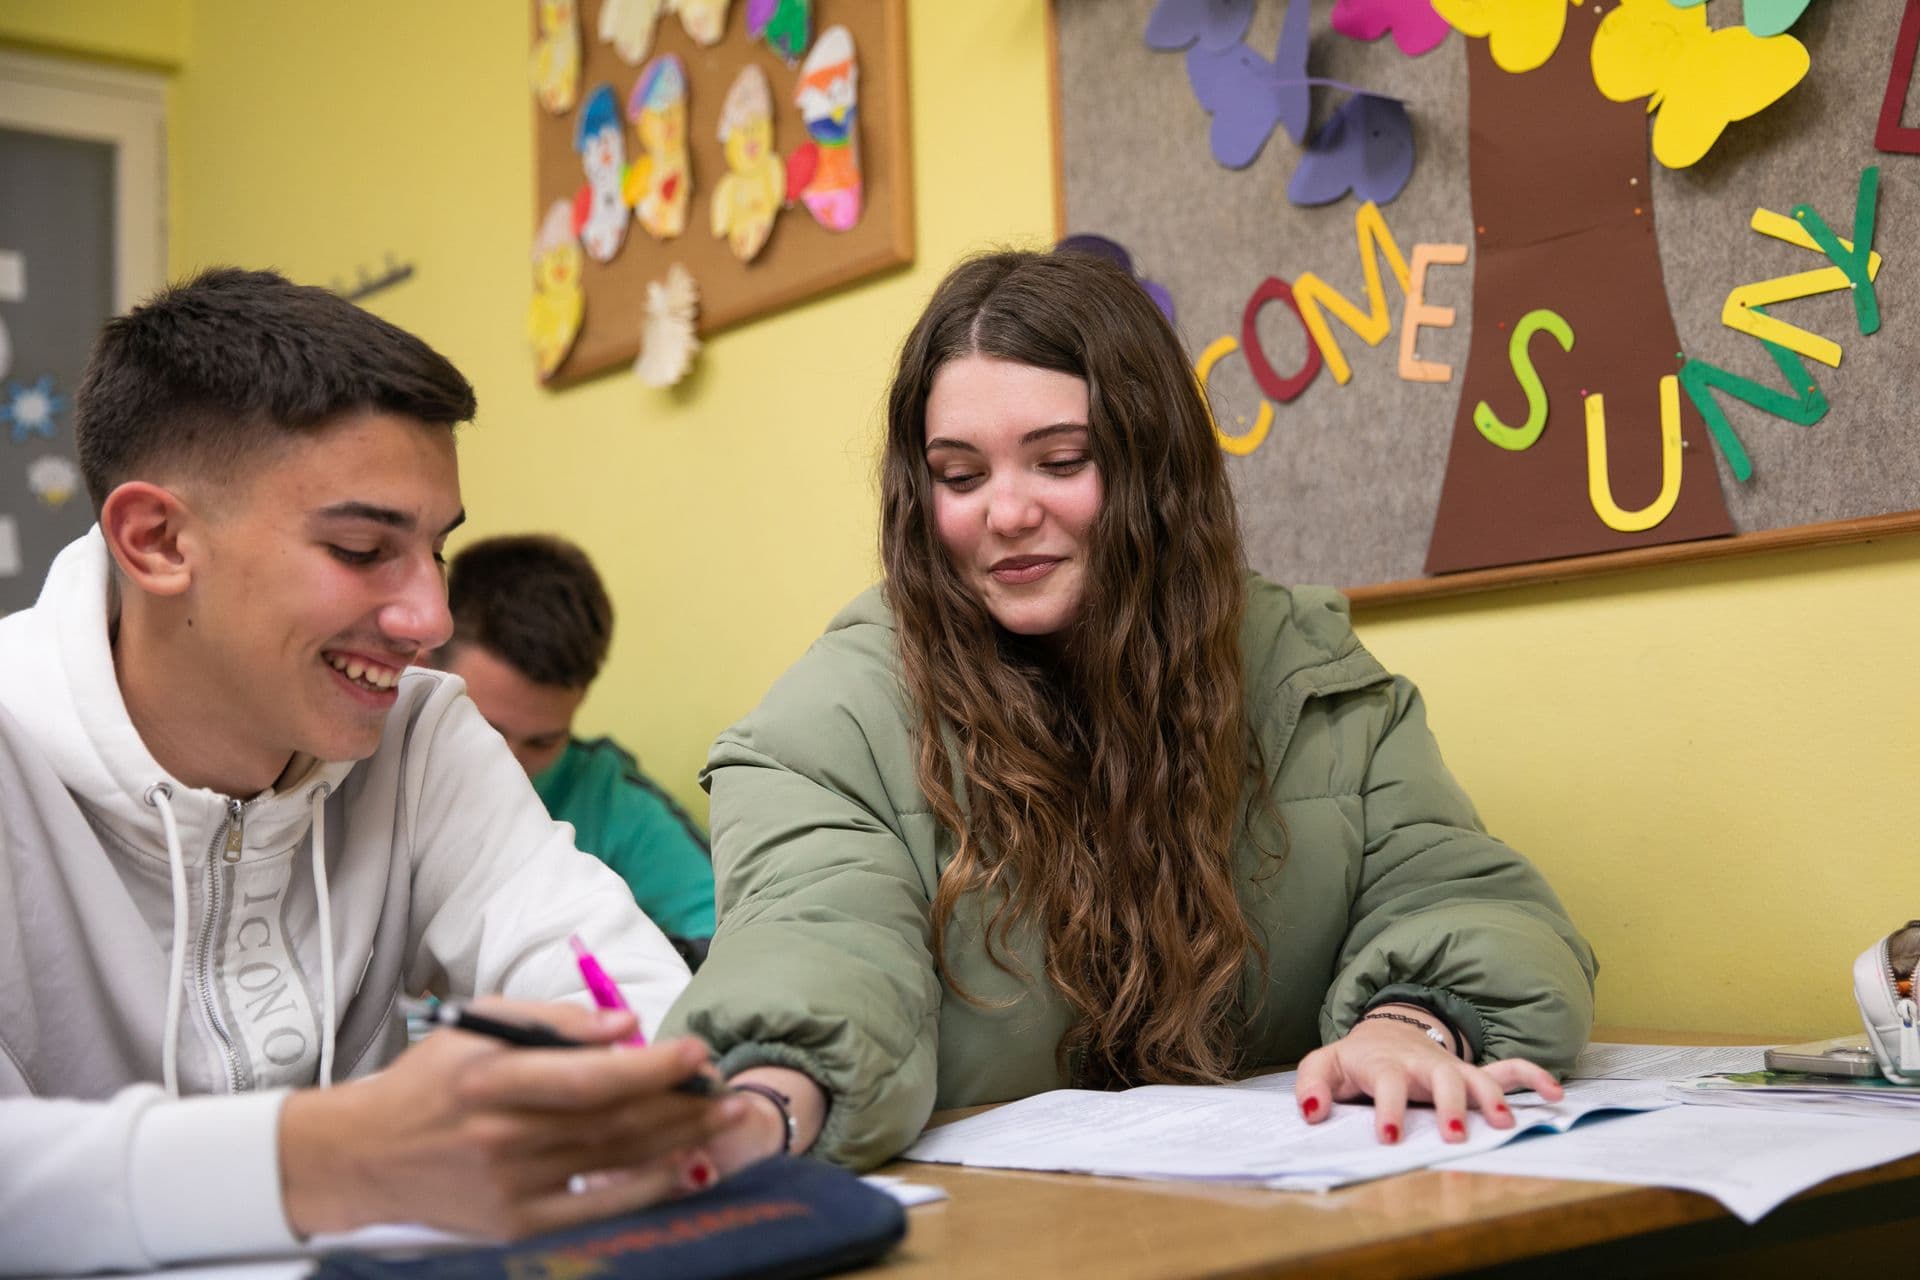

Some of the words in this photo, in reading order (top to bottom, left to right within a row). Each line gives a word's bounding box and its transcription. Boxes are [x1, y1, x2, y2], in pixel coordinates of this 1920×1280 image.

[1195, 200, 1468, 456] COME
[1473, 166, 1882, 532] SUNNY
[237, 888, 306, 1066] ICONO
